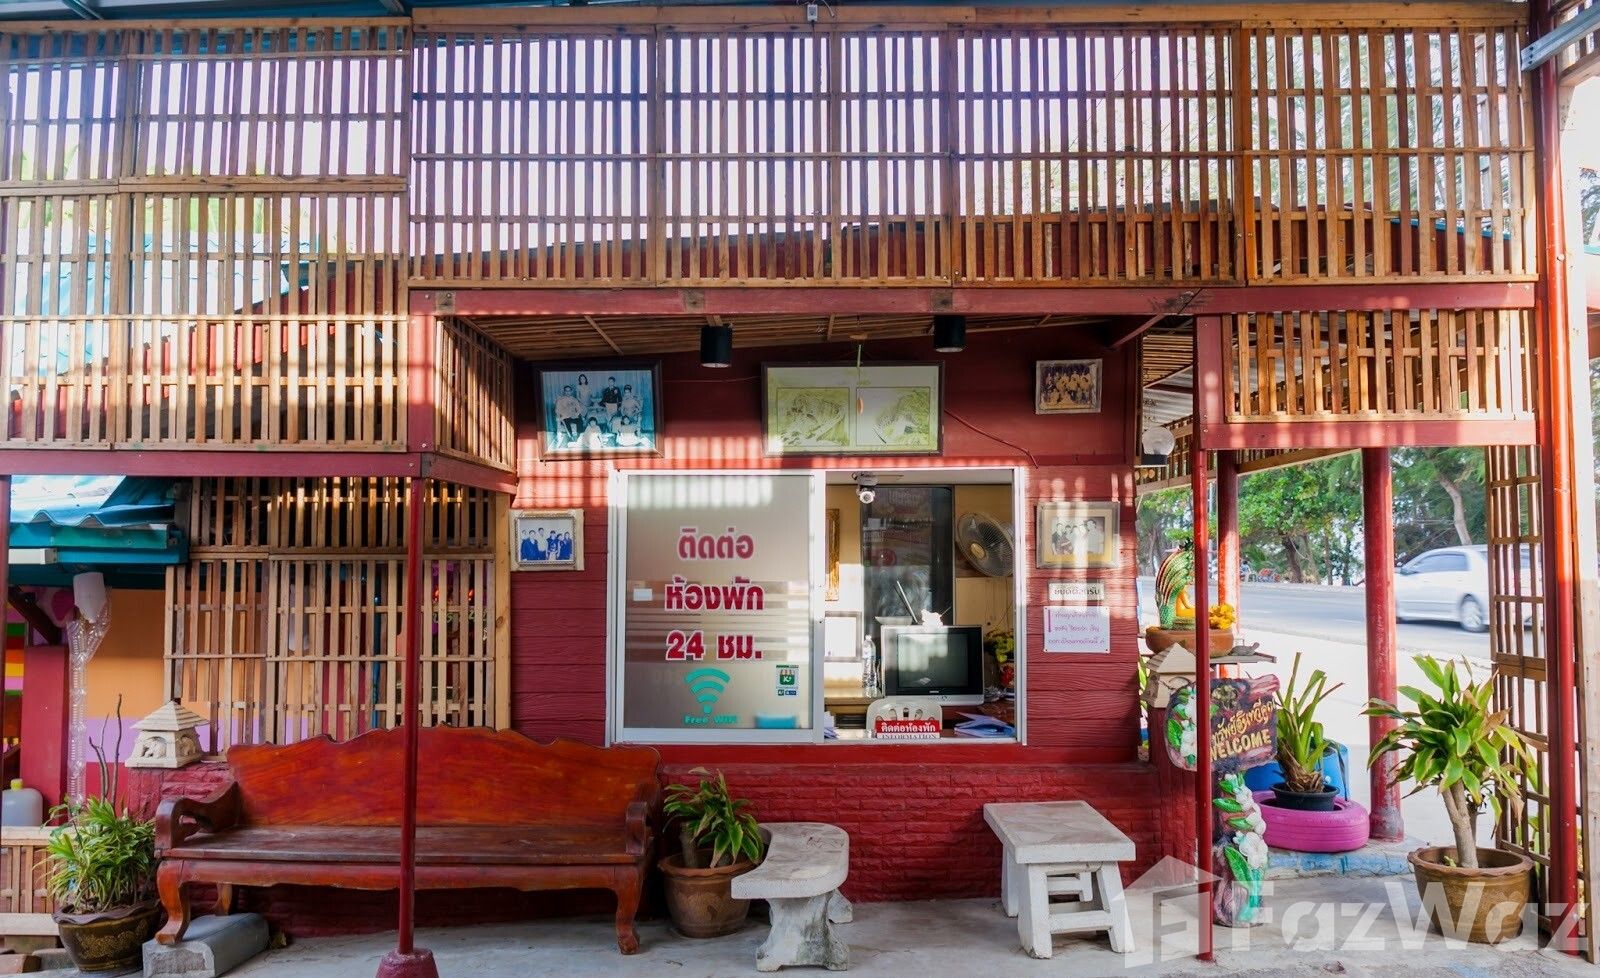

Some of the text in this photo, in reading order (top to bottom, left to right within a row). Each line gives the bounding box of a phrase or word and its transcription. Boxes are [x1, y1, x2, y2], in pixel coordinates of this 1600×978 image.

[678, 526, 754, 560] ติดต่อ
[665, 575, 764, 611] ห้องพัก
[666, 630, 763, 661] 24 ชม.
[684, 715, 708, 724] Free
[881, 721, 936, 732] ติดต่อห้องพัก
